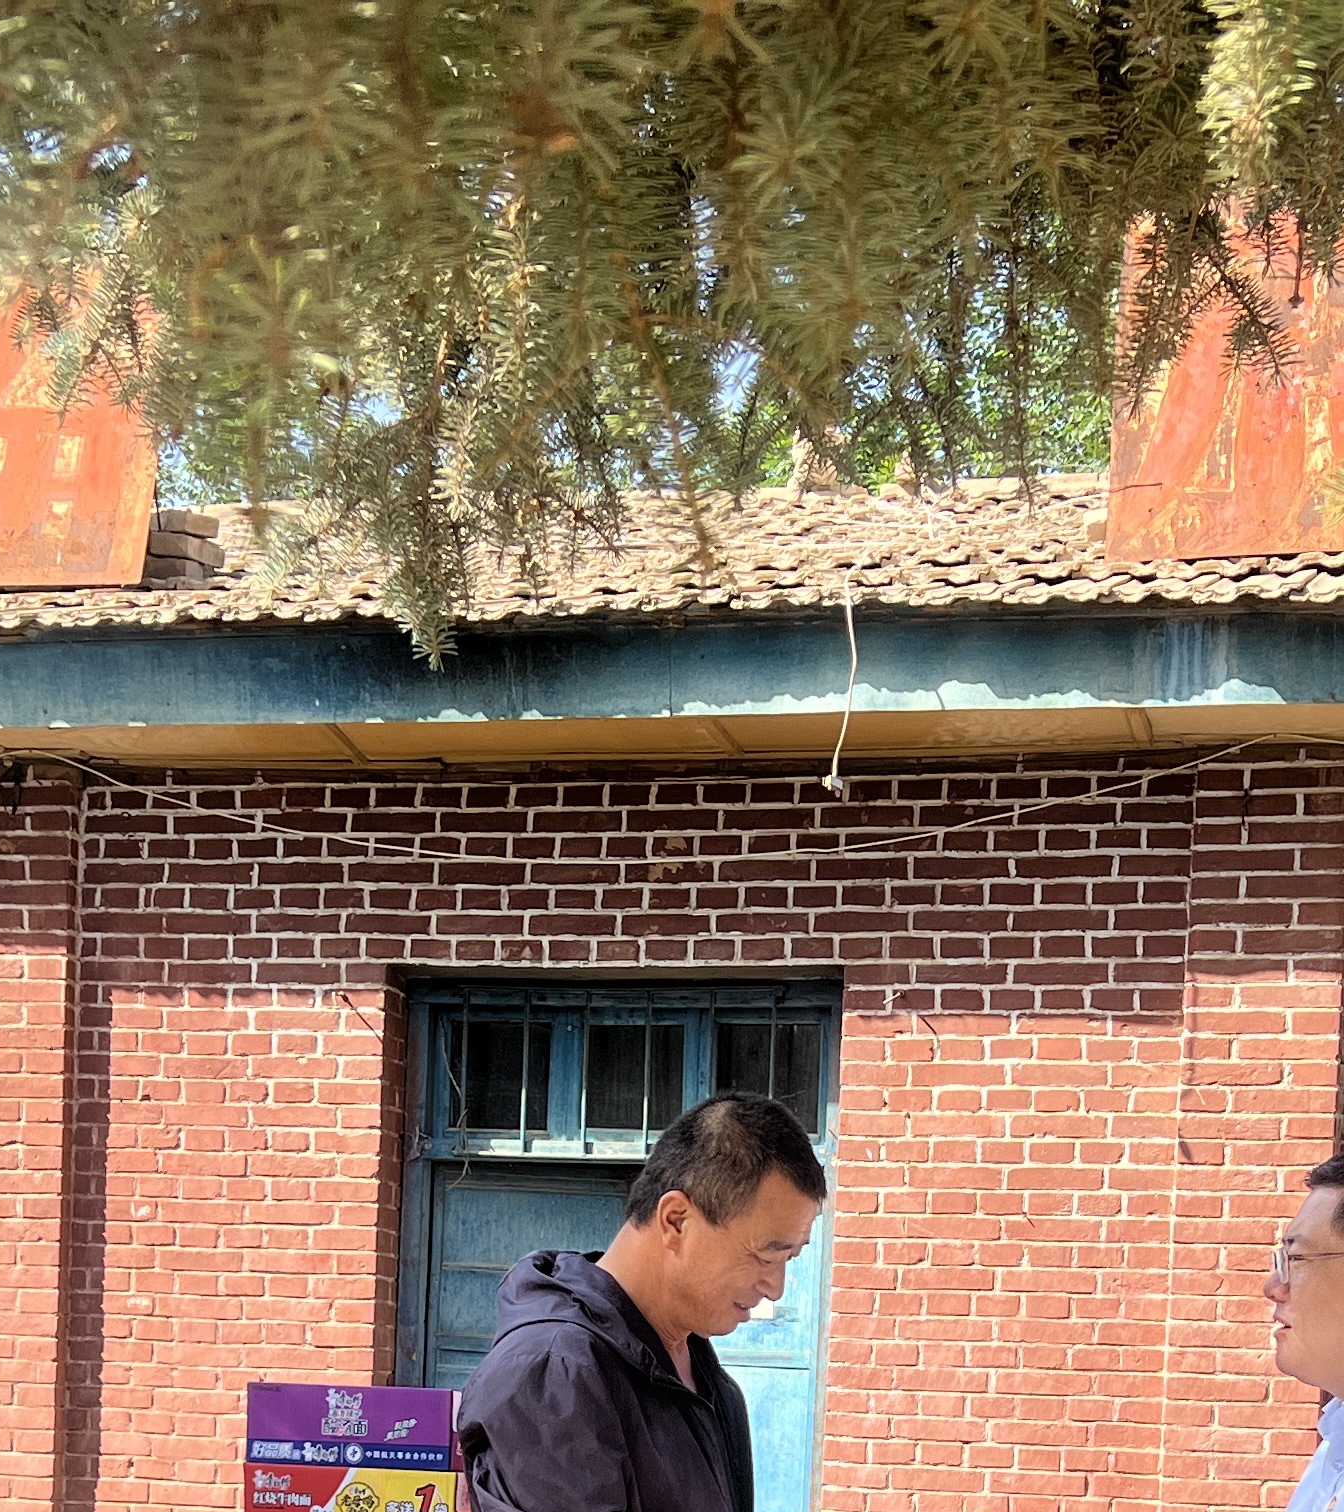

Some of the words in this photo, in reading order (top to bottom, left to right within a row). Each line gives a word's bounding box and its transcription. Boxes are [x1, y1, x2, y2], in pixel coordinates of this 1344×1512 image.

[253, 1491, 312, 1506] 红烧牛肉面
